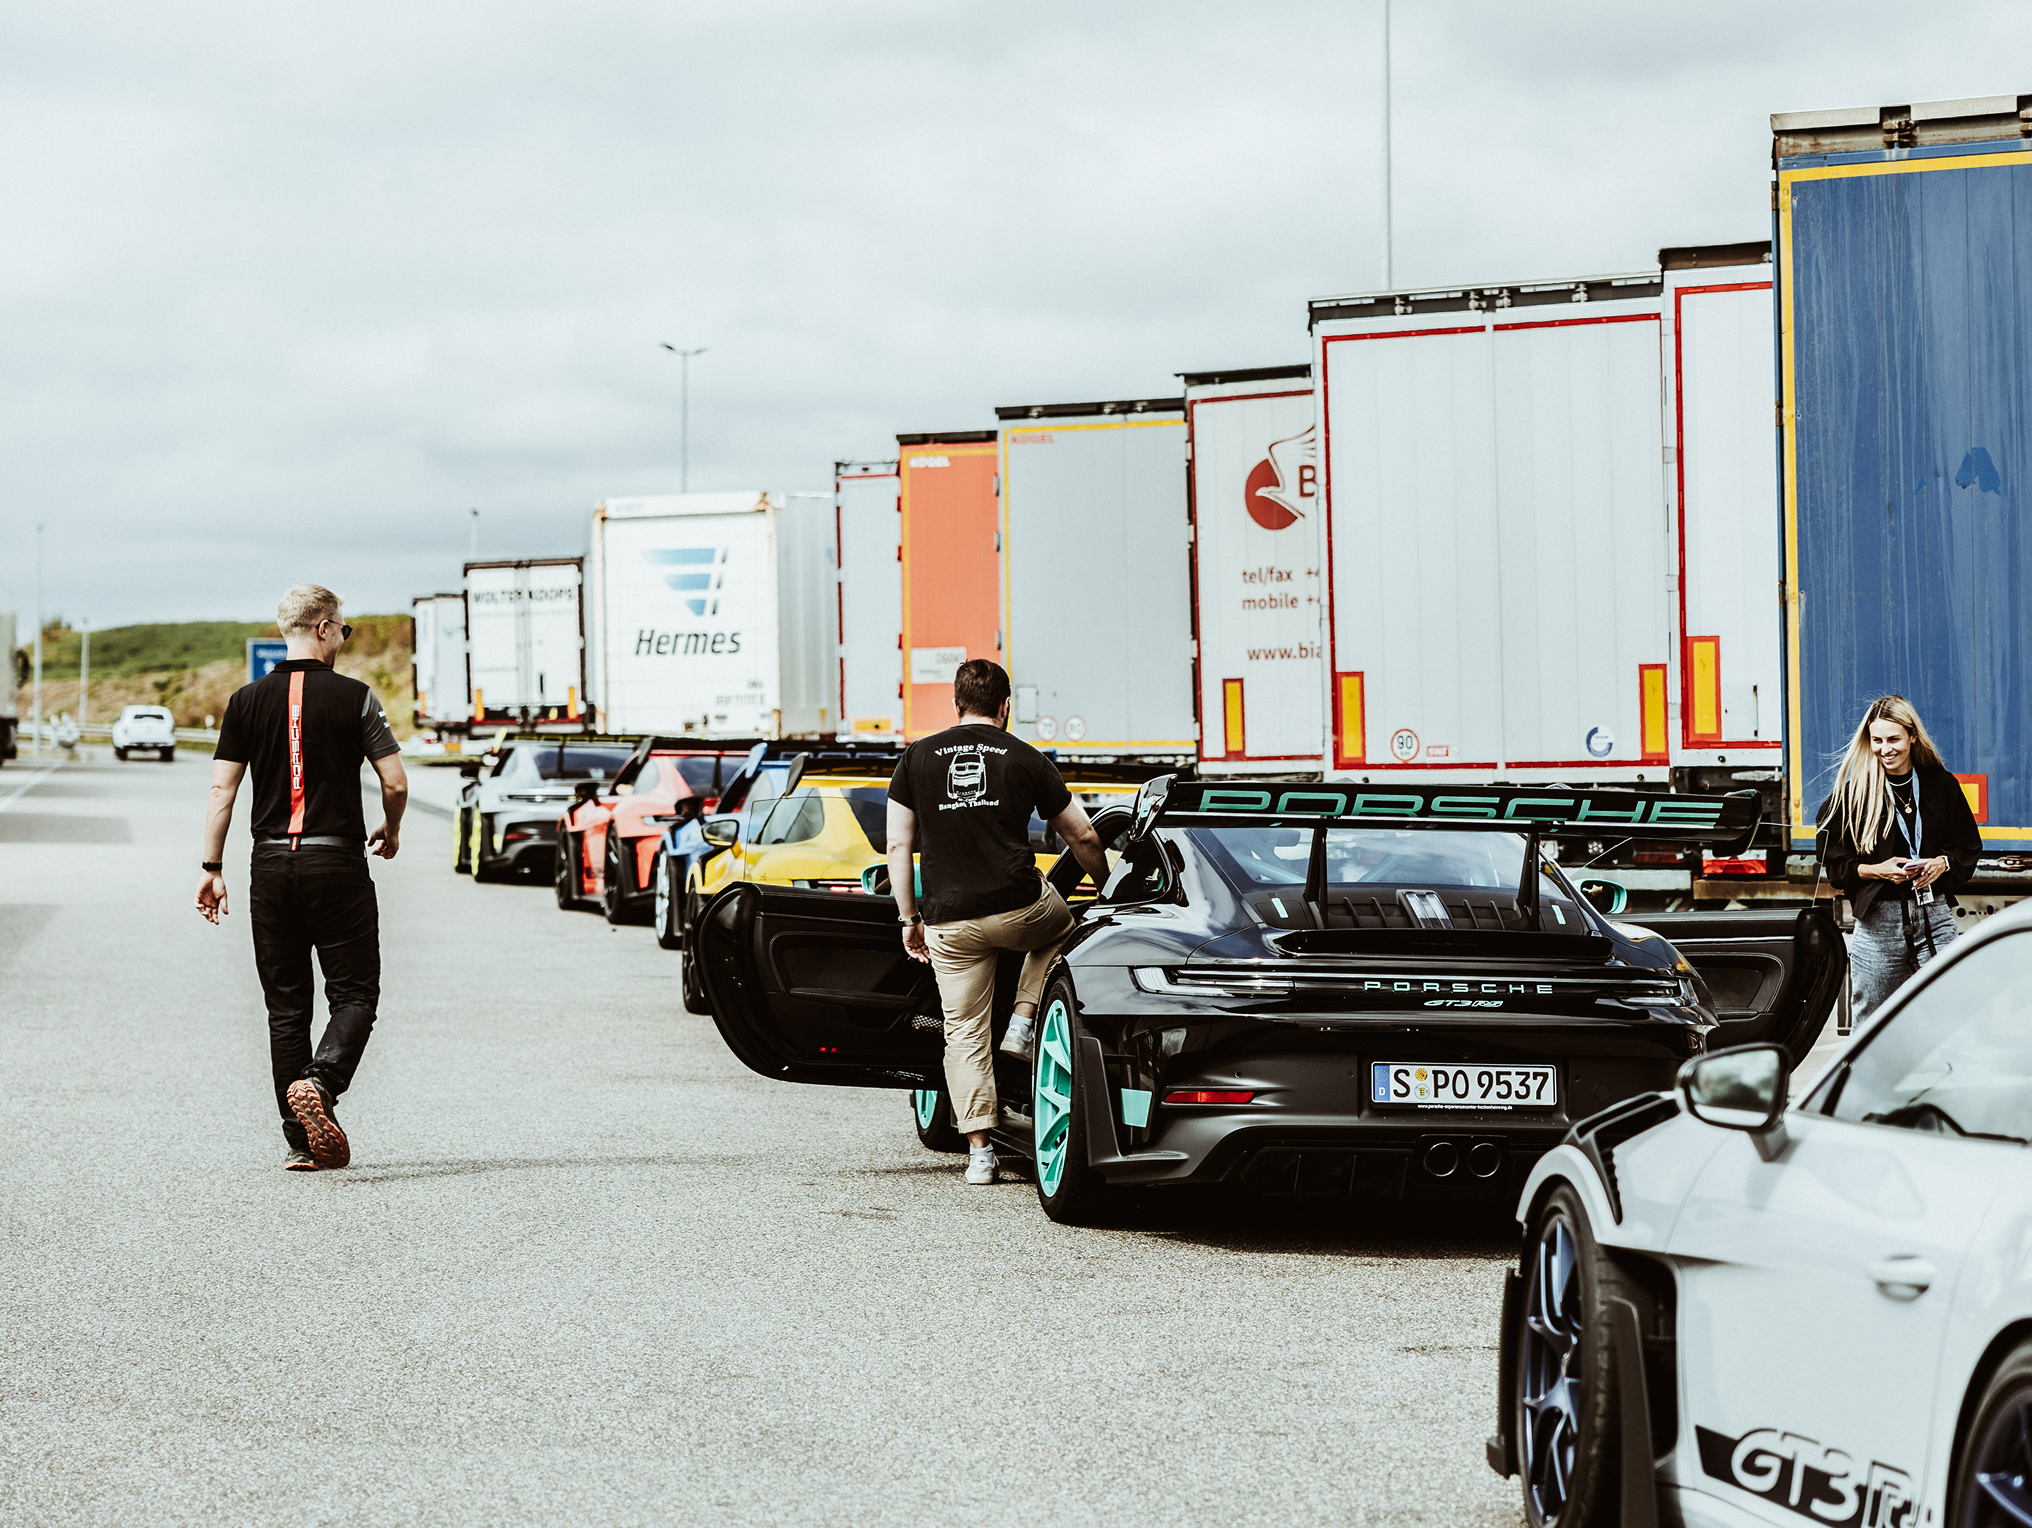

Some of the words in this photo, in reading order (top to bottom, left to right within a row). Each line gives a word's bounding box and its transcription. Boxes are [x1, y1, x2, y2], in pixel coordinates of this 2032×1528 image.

[1242, 566, 1293, 586] tel/fax
[1242, 592, 1299, 610] mobile
[635, 629, 741, 655] Hermes
[291, 704, 301, 790] PORSCHE
[934, 744, 975, 757] Vintage
[976, 743, 1008, 756] Speed
[1397, 735, 1413, 750] 90
[968, 799, 999, 808] Thailand
[1200, 789, 1724, 826] PORSCHE
[1364, 981, 1553, 994] PORSCHE
[1378, 1087, 1386, 1096] D
[1393, 1069, 1411, 1098] S
[1431, 1069, 1470, 1099] PO
[1476, 1070, 1550, 1100] 9537
